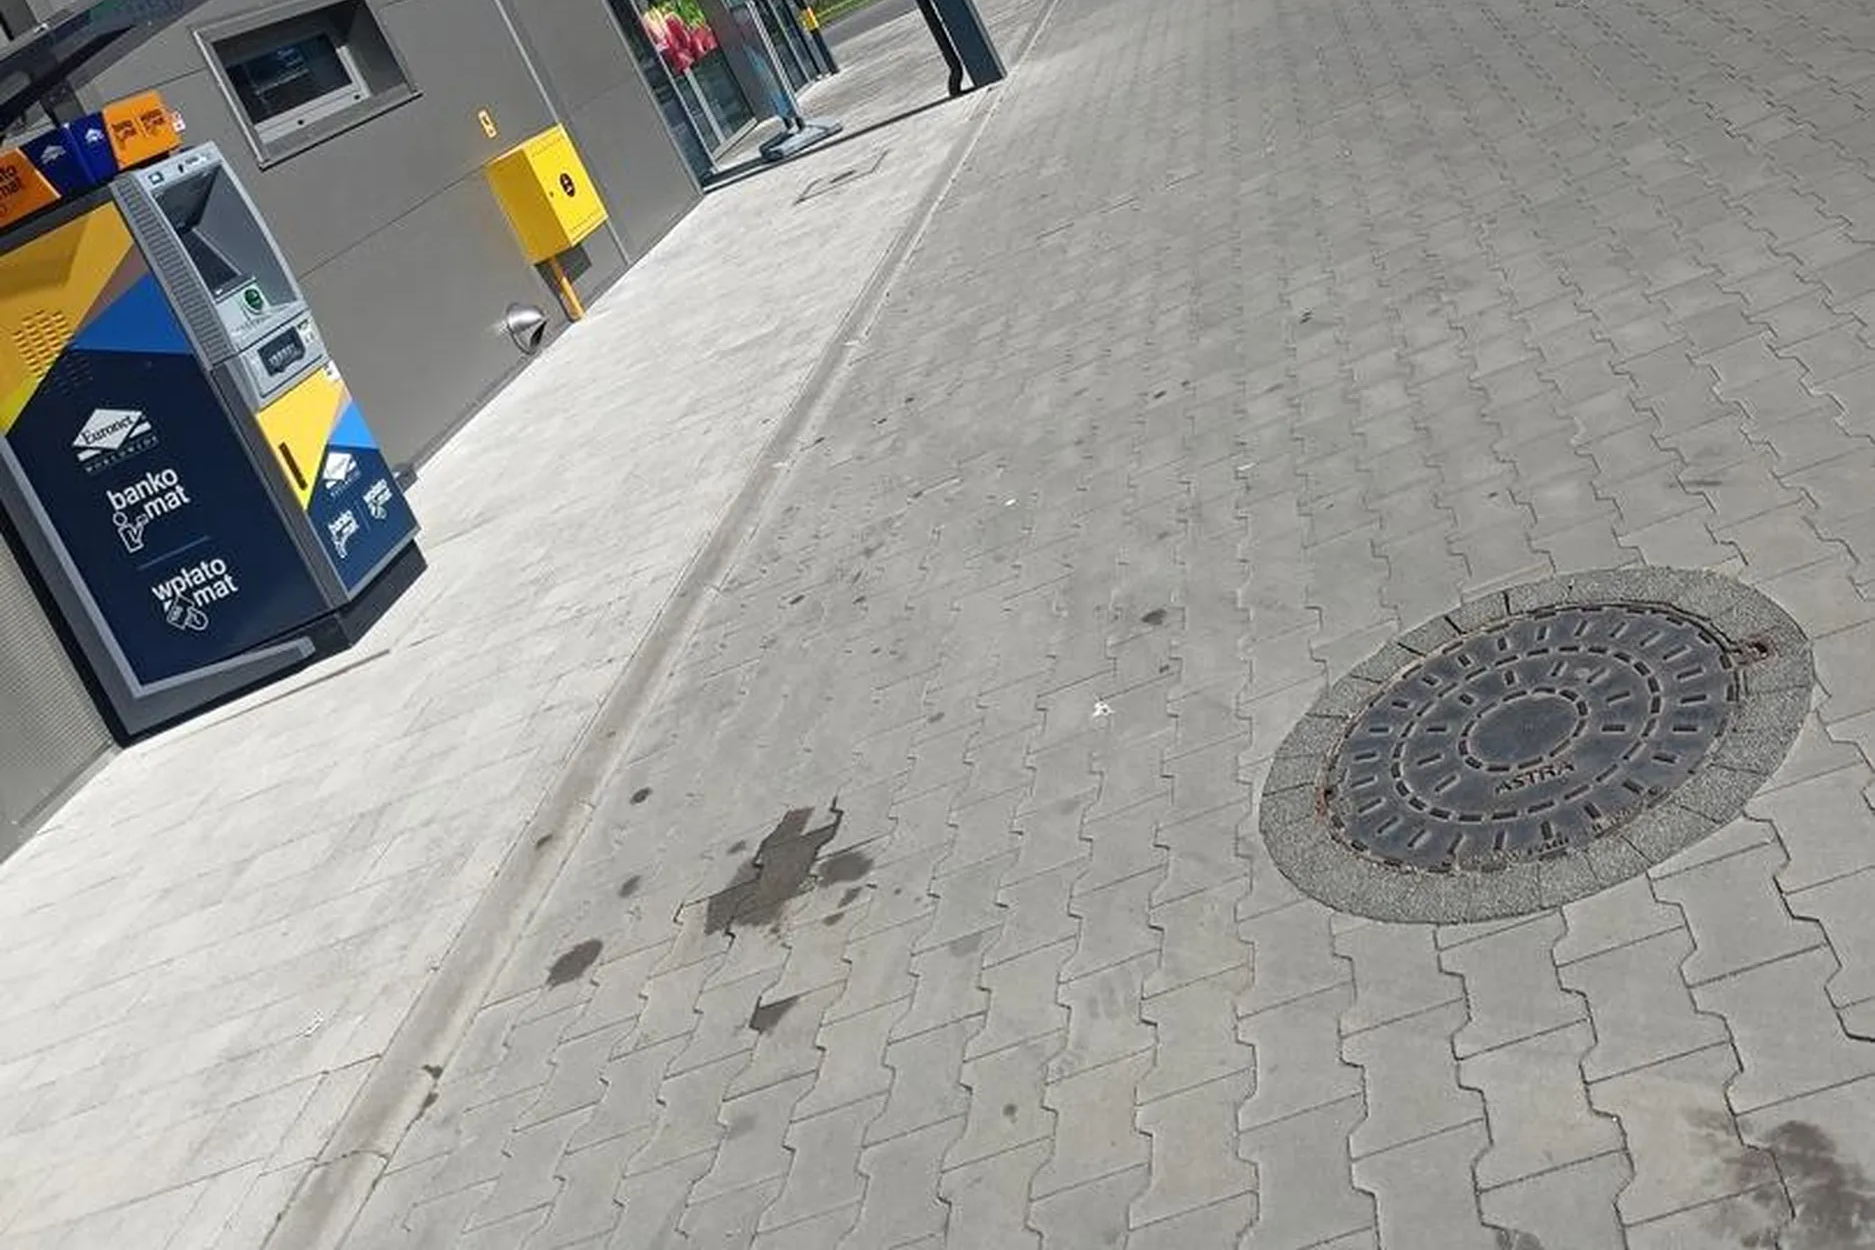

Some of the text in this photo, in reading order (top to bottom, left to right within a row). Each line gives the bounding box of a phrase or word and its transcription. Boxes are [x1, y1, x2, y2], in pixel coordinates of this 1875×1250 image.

[81, 415, 134, 445] Euronet
[106, 468, 179, 512] banko
[143, 484, 191, 520] mat
[151, 557, 227, 602] wpłato
[192, 573, 239, 607] mat
[1493, 760, 1577, 796] ASTRA
